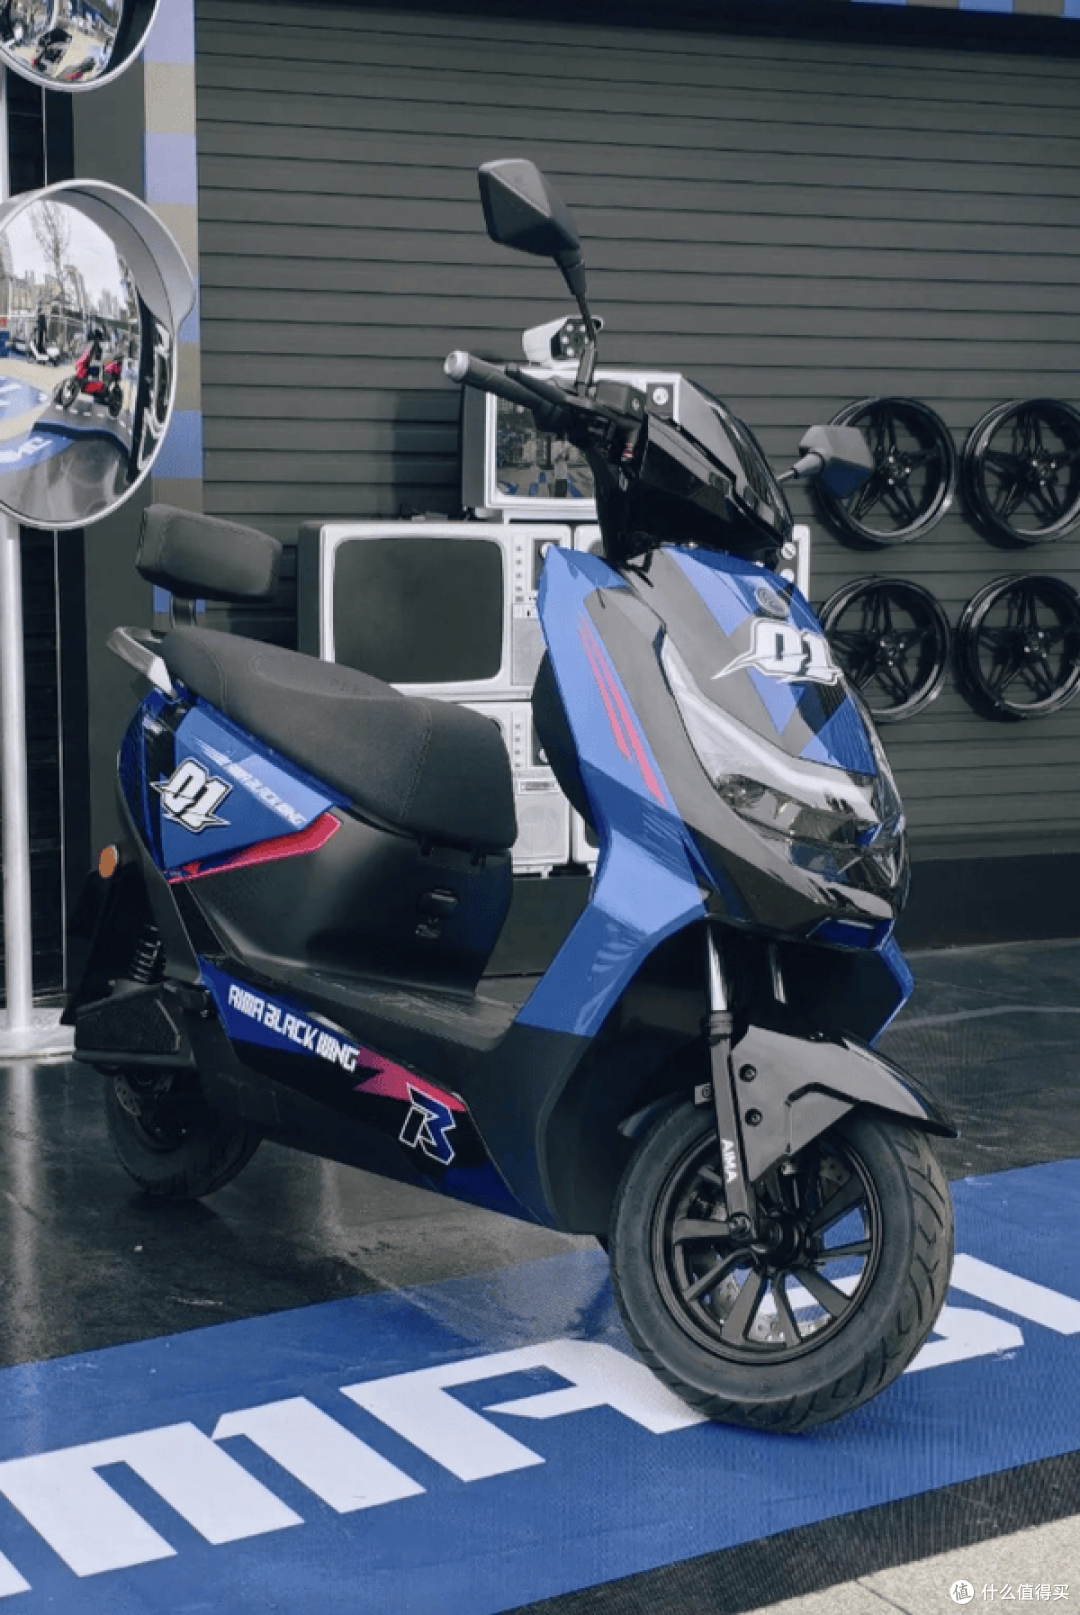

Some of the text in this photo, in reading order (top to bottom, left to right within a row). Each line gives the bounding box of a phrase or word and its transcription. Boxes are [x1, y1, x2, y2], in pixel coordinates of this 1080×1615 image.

[263, 1001, 318, 1050] BLACK
[315, 1031, 360, 1073] WING
[722, 1139, 738, 1183] AIMA
